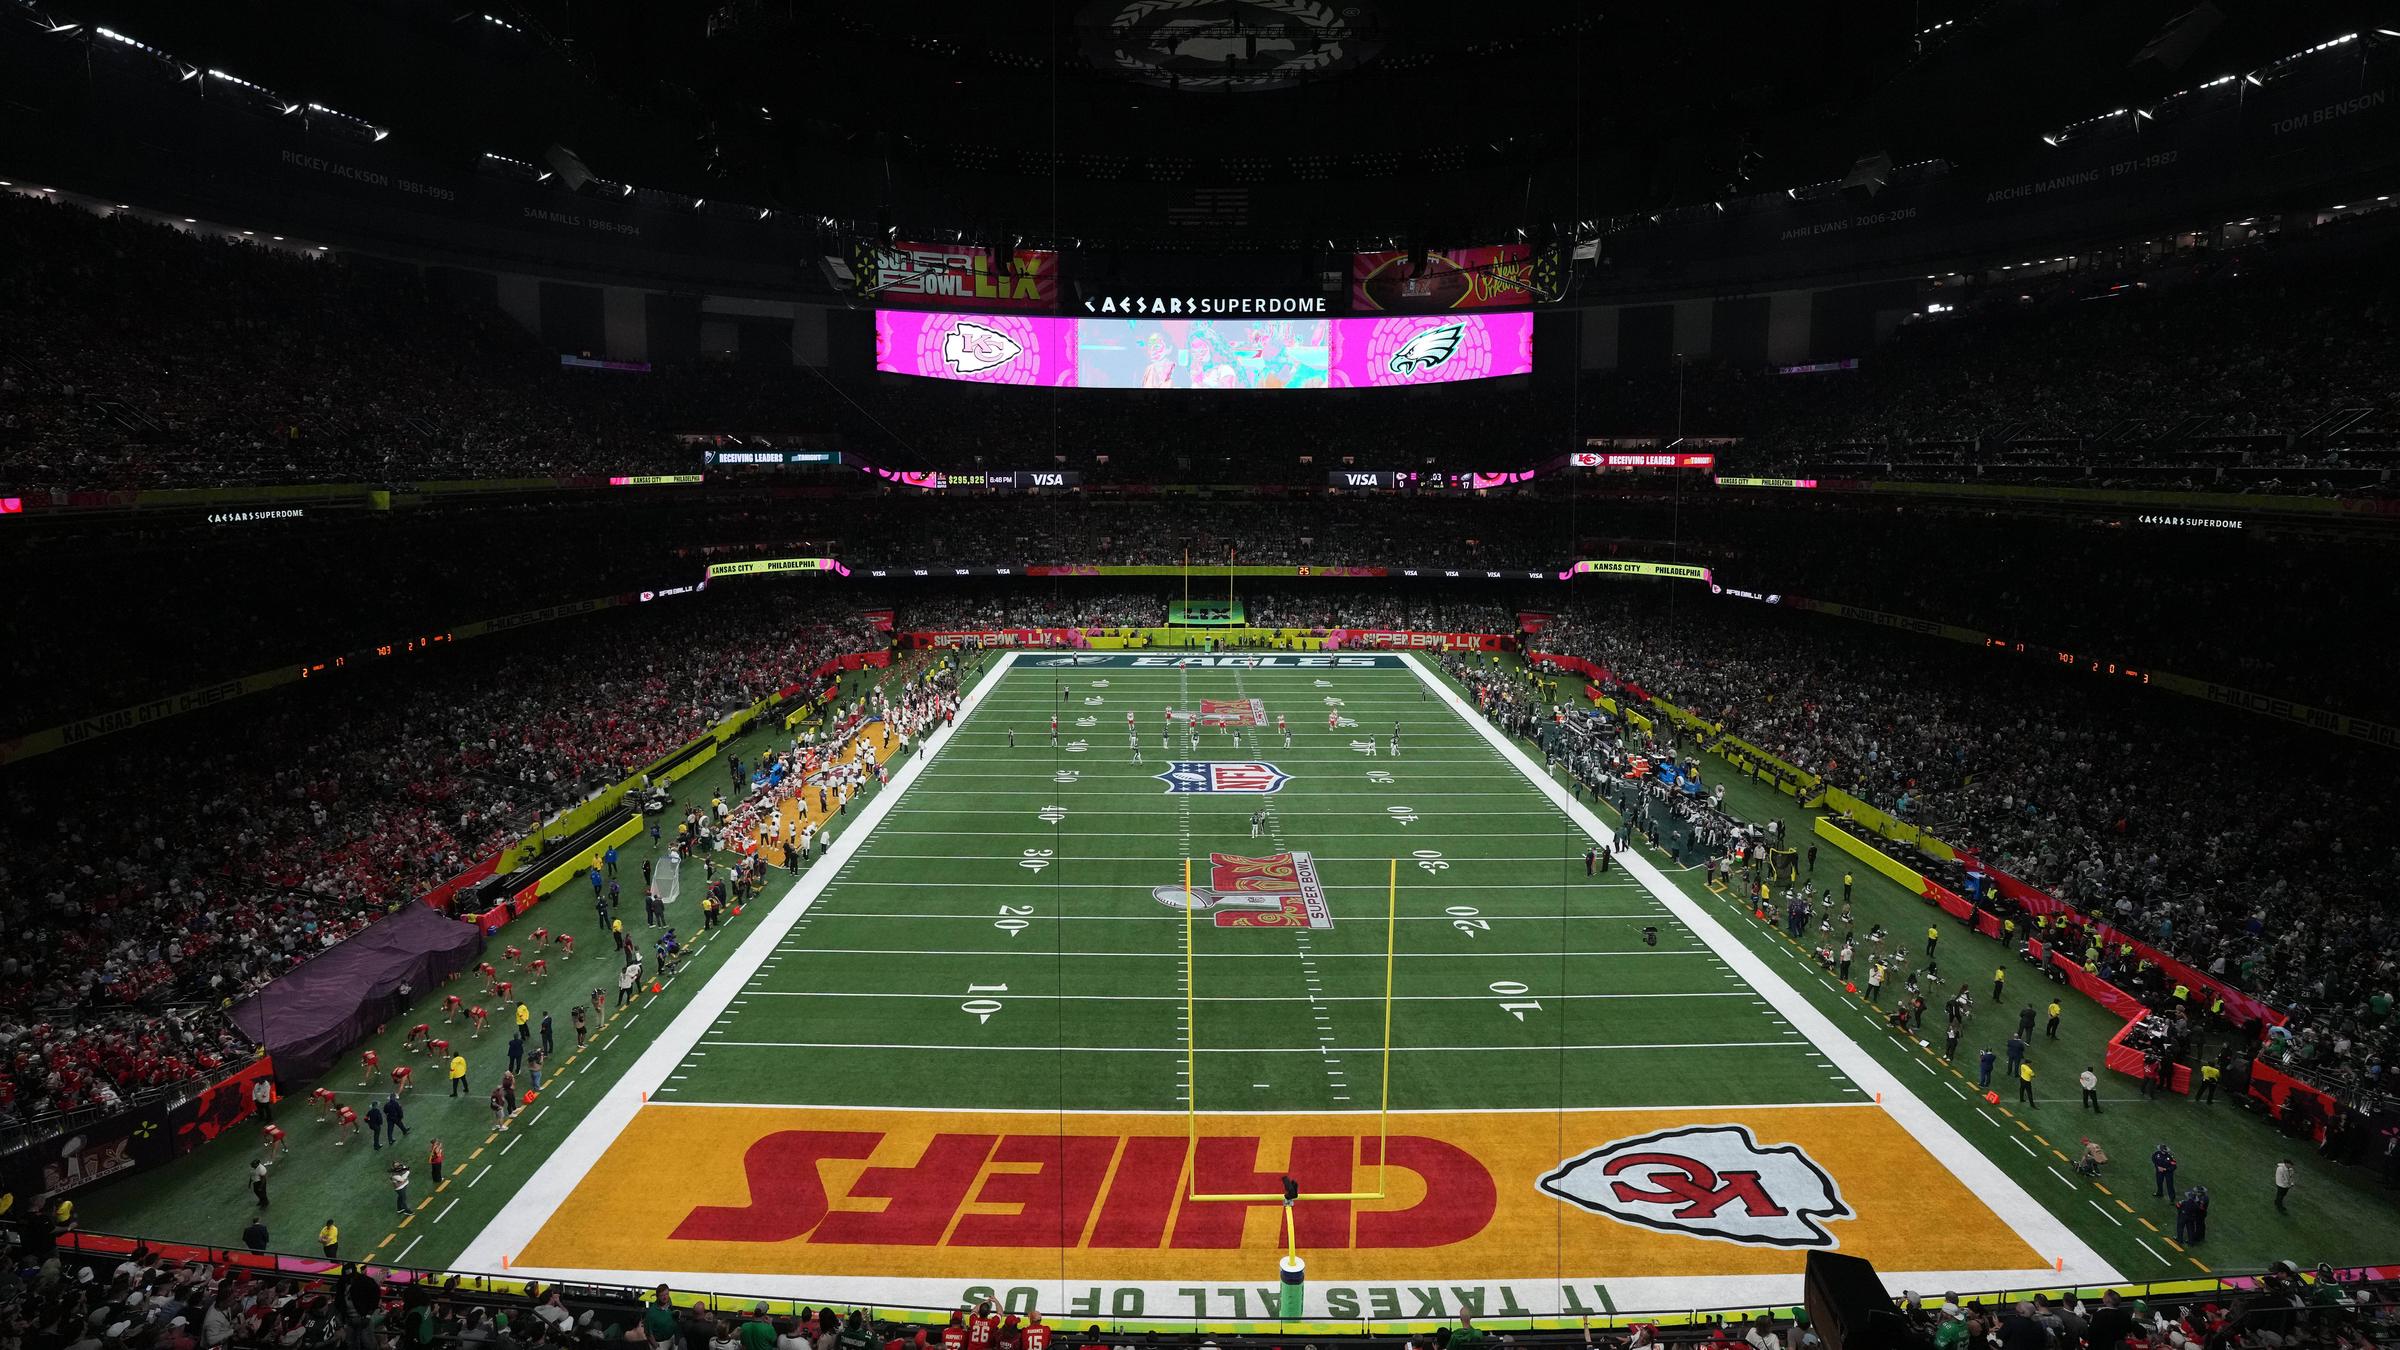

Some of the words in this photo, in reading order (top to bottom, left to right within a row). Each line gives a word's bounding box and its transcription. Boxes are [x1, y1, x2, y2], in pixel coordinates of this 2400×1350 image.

[2272, 114, 2308, 135] TOM
[2313, 89, 2384, 124] BENSON
[281, 150, 328, 172] RICKEY
[331, 163, 388, 187] JACKSON
[397, 179, 455, 201] 1981-1993
[1985, 183, 2032, 204] ARCHIE
[2035, 168, 2100, 193] MANNING
[2110, 150, 2178, 177] 1971-1982
[523, 207, 548, 220] SAM
[550, 212, 580, 226] MILLS
[588, 219, 640, 235] 1986-1994
[1780, 227, 1811, 241] JAHRI
[1814, 220, 1848, 235] EVANS
[1856, 207, 1917, 227] 2006-2016
[877, 250, 973, 275] SUPER
[878, 268, 974, 297] BOWL
[719, 453, 754, 463] RECEIVING
[754, 453, 783, 462] LEADERS
[1608, 456, 1645, 465] RECEIVING
[1645, 456, 1676, 465] LEADERS
[1031, 473, 1063, 486] VISA
[1345, 473, 1378, 486] VISA
[712, 564, 736, 574] KANSAS
[738, 563, 754, 572] CITY
[767, 560, 816, 570] PHILADELPHIA
[1299, 567, 1309, 575] 25
[1594, 563, 1623, 572] KANSAS
[1624, 564, 1641, 573] CITY
[1655, 566, 1701, 578] PHILADELPHIA
[1131, 656, 1376, 667] EAGLES
[1053, 770, 1080, 783] 50
[1215, 764, 1275, 790] NFL
[1366, 770, 1395, 784] 50
[1038, 804, 1068, 820] 40
[1387, 806, 1419, 821] 40
[1018, 849, 1053, 868] 30
[1296, 858, 1313, 881] BOWL
[1412, 850, 1450, 869] 30
[1304, 882, 1325, 919] SUPER
[994, 905, 1034, 929] 20
[1445, 906, 1491, 930] 20
[961, 983, 1008, 1013] 10
[1489, 981, 1543, 1012] 10
[666, 1129, 1498, 1250] CHIEFS
[1602, 1152, 1789, 1219] KC
[961, 1286, 1039, 1314] US
[1071, 1286, 1145, 1318] OF
[1178, 1287, 1285, 1318] ALL
[1326, 1286, 1531, 1319] TAKES
[1562, 1284, 1618, 1315] IT
[971, 1325, 990, 1343] 26
[1027, 1335, 1043, 1350] 15
